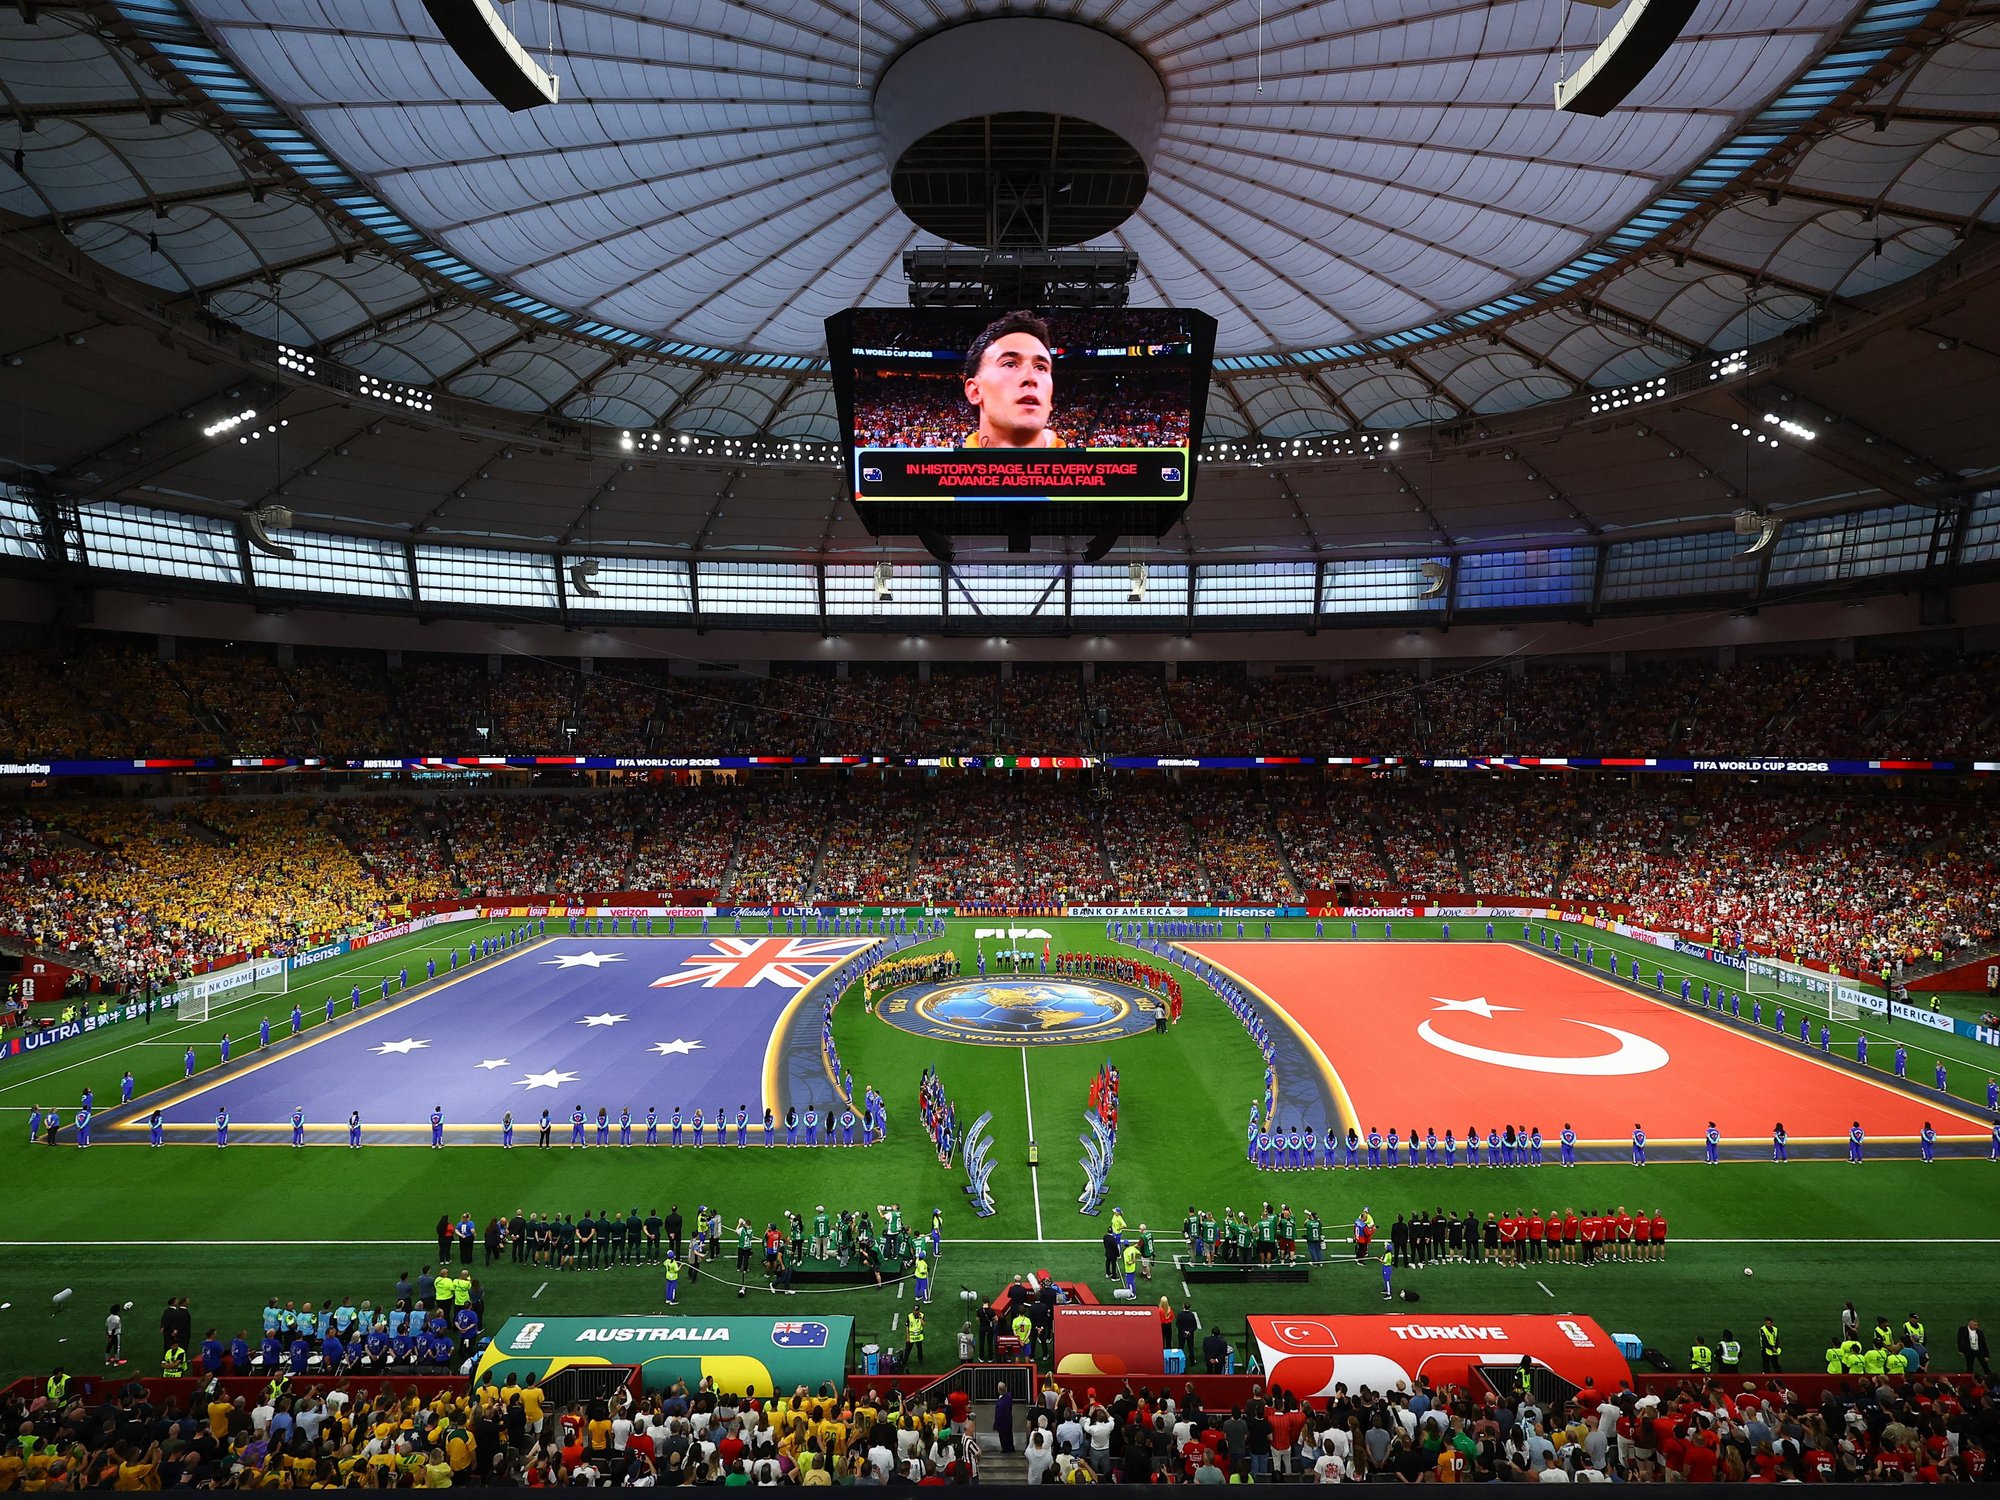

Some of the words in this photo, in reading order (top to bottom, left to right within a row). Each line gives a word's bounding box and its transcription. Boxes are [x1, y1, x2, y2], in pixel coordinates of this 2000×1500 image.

[865, 349, 892, 357] WORLD
[893, 350, 907, 358] CUP
[1097, 348, 1126, 356] AUSTRALIA
[906, 464, 920, 475] IN
[921, 464, 987, 475] HISTORY'S
[988, 464, 1025, 477] PAGE,
[1027, 464, 1048, 475] LET
[1052, 464, 1094, 475] EVERY
[1095, 464, 1137, 475] STAGE
[938, 476, 1000, 486] ADVANCE
[1001, 476, 1073, 486] AUSTRALIA
[1075, 476, 1106, 486] FAIR.
[363, 760, 402, 768] AUSTRALIA
[616, 759, 636, 767] FIFA
[636, 759, 670, 767] WORLD
[670, 759, 689, 767] CUP
[689, 759, 720, 767] 2026
[1157, 759, 1200, 768] #FIFAWorldCup
[1434, 760, 1467, 768] AUSTRALIA
[1693, 761, 1717, 770] FIFA
[1719, 761, 1761, 771] WORLD
[1763, 762, 1785, 771] CUP
[1786, 763, 1829, 772] 2026
[610, 908, 648, 916] verizon
[665, 908, 703, 916] verizon
[730, 907, 771, 917] Michelob
[782, 908, 822, 916] ULTRA
[1073, 908, 1102, 916] BANK
[1106, 908, 1119, 916] OF
[1122, 908, 1172, 916] AMERICA
[1219, 907, 1275, 917] Hisense
[1343, 907, 1414, 917] McDonald's
[1437, 908, 1461, 917] Dove
[1489, 908, 1515, 917] Dove
[367, 925, 409, 945] McDonald's
[1629, 929, 1657, 945] verizon
[293, 946, 341, 969] Hisense
[1676, 942, 1705, 958] Michelob
[1713, 952, 1746, 971] ULTRA
[223, 978, 233, 988] OF
[235, 967, 271, 984] AMEICA
[1841, 990, 1867, 1006] BANK
[1871, 999, 1883, 1009] OF
[25, 1022, 80, 1050] ULTRA
[928, 1028, 961, 1039] FIFA
[965, 1034, 1029, 1043] WORLD
[1069, 1027, 1124, 1041] 2026
[575, 1327, 730, 1341] AUSTRALIA
[1389, 1324, 1509, 1339] TÜRKİYE
[1450, 1458, 1464, 1471] 10
